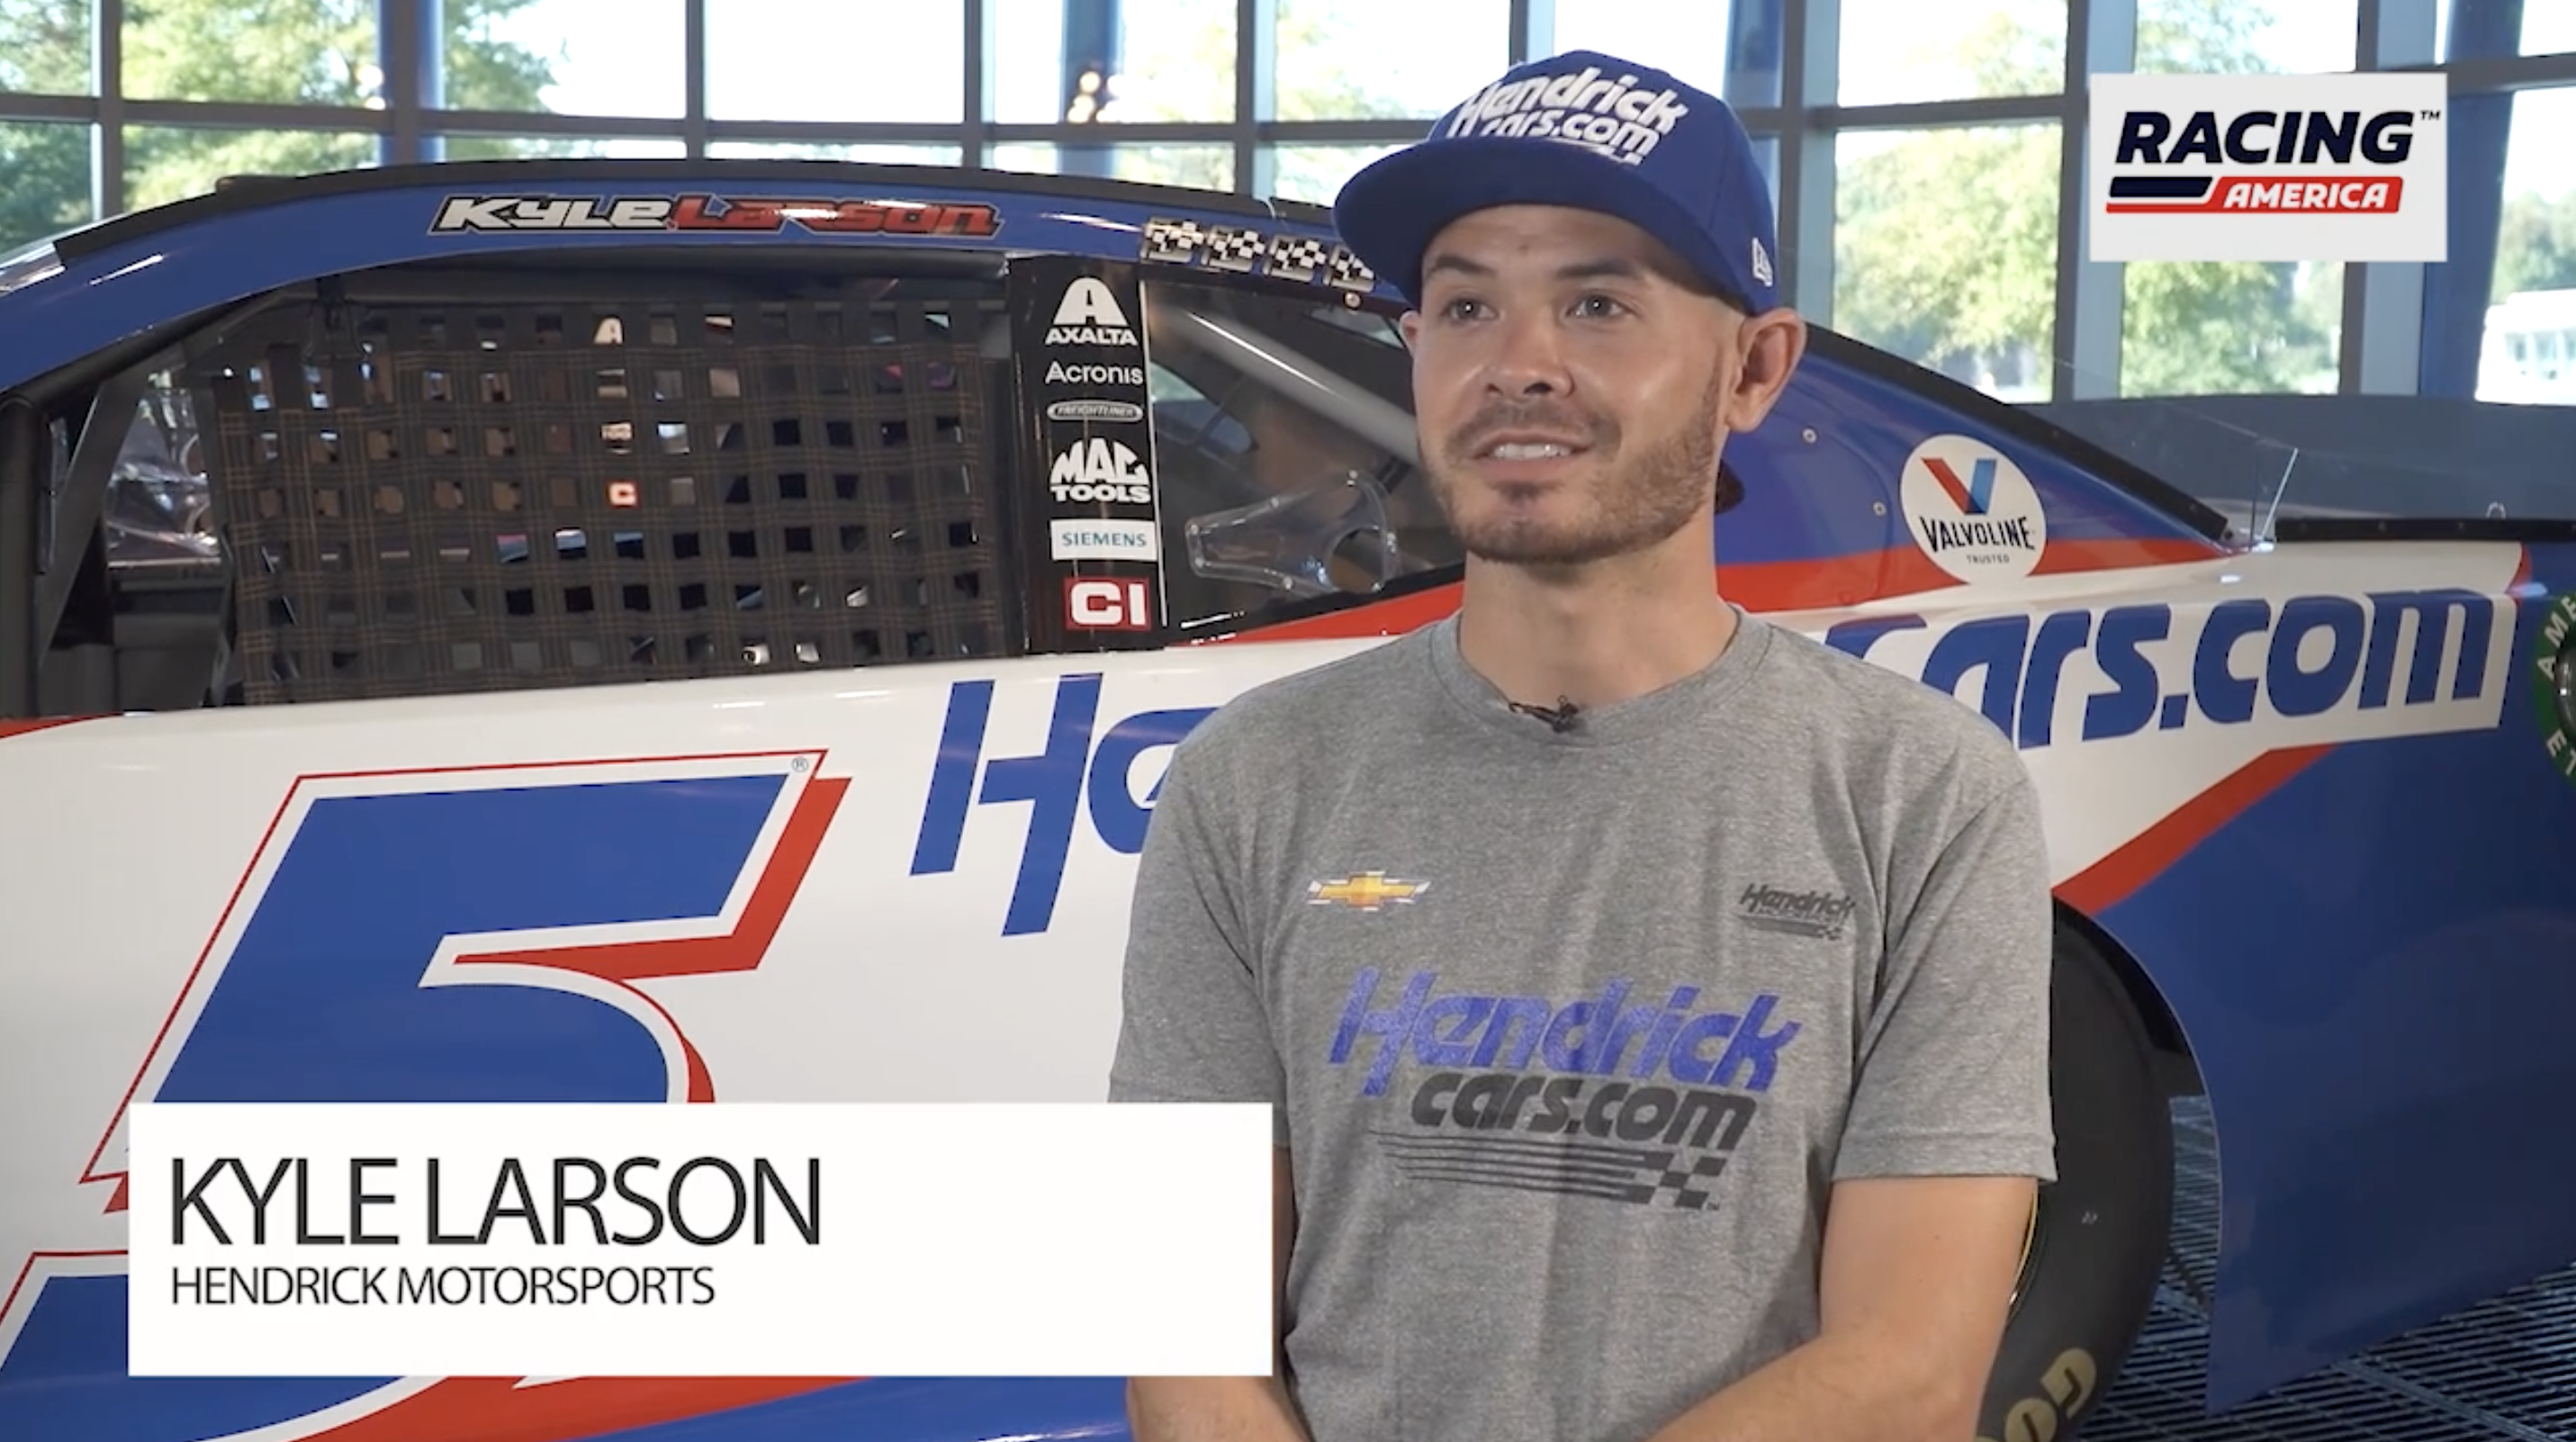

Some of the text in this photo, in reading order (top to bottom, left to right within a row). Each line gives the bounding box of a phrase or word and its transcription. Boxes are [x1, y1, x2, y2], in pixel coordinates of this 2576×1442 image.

[1446, 67, 1689, 139] Hendrick
[1046, 328, 1137, 345] AXALTA
[1046, 362, 1143, 383] Acronis
[1050, 438, 1148, 485] MAC
[1050, 486, 1150, 502] TOOLS
[1063, 533, 1146, 545] SIEMENS
[1918, 516, 2036, 553] VALVOLINE
[1070, 581, 1147, 626] CI
[1329, 966, 1801, 1097] Hendrick
[1410, 1071, 1756, 1150] cars.com
